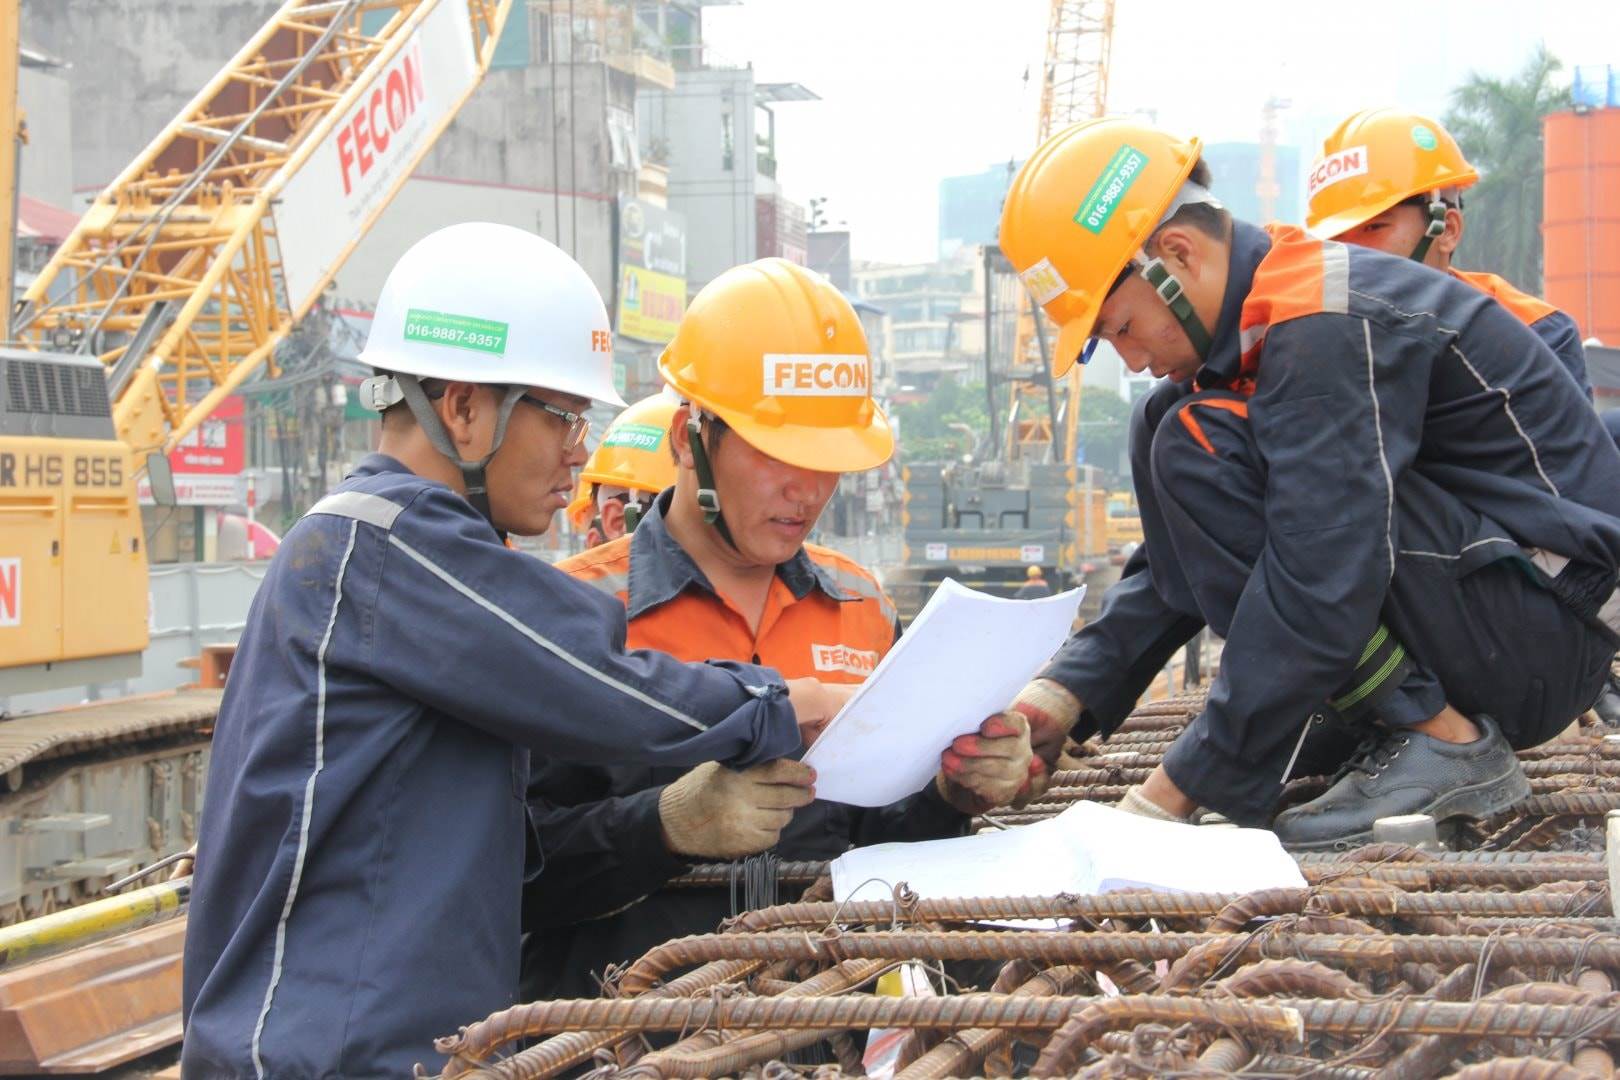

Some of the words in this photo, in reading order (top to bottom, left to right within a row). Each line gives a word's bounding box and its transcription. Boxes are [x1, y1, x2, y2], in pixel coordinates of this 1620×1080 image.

[336, 44, 424, 197] FECON
[1087, 153, 1142, 227] 016-9887-9357
[407, 323, 503, 349] 016-9887-9357
[774, 362, 867, 390] FECON
[25, 454, 63, 487] HS
[74, 456, 123, 487] 855
